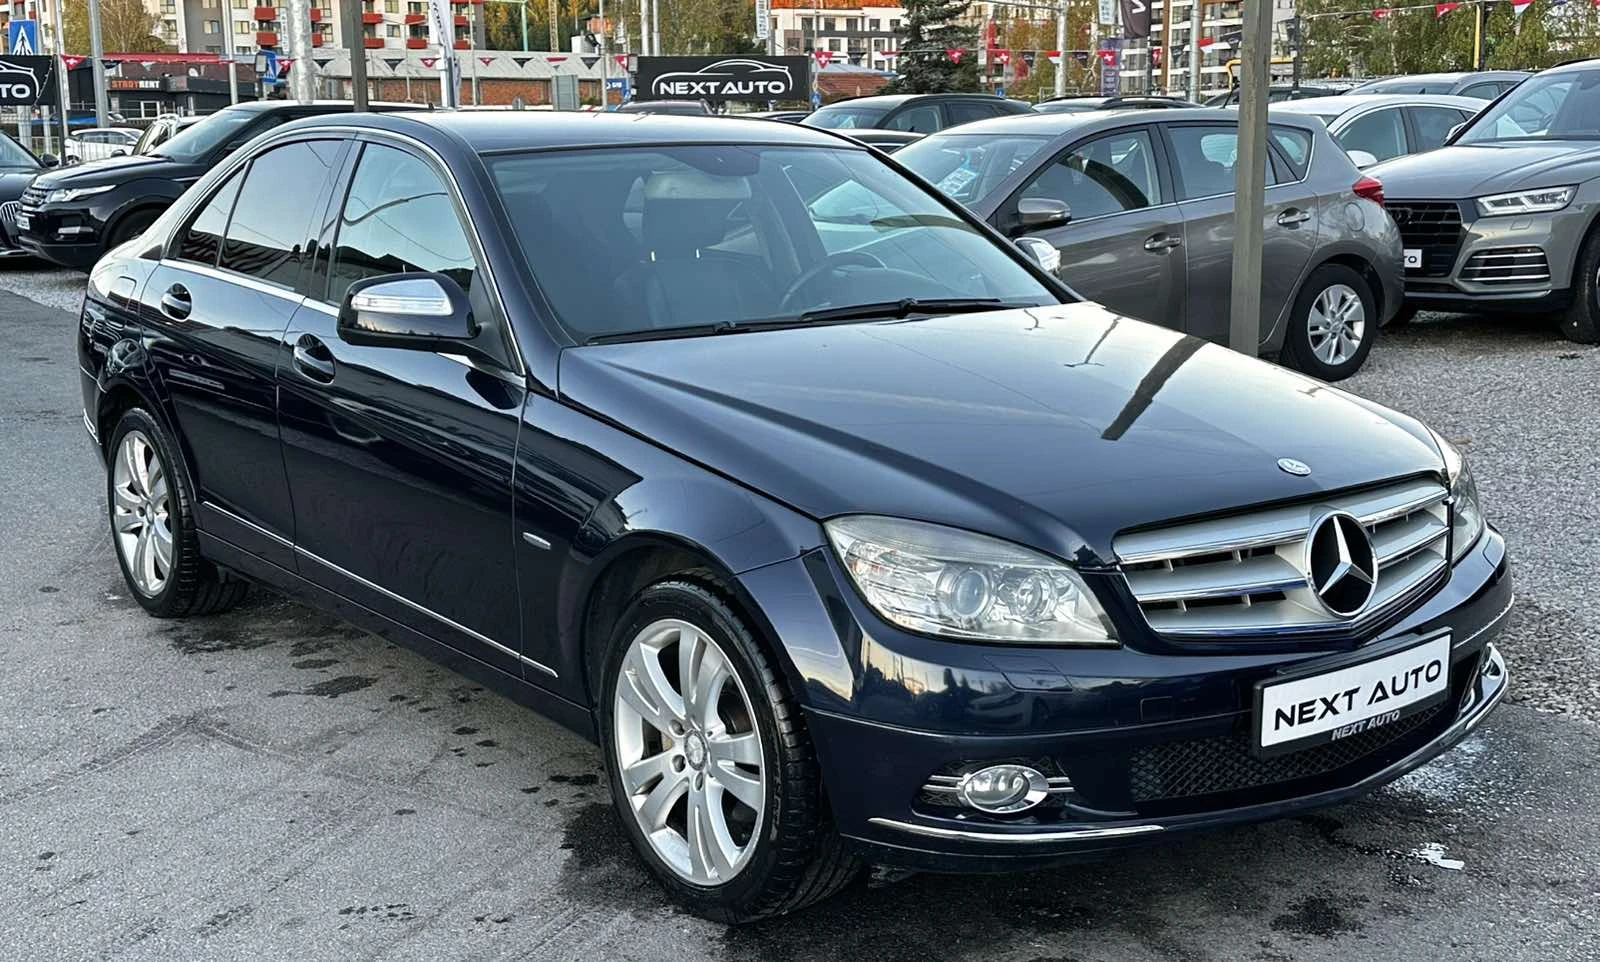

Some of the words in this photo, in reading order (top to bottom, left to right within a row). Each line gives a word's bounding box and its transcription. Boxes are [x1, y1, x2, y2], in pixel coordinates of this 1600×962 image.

[660, 81, 720, 95] NEXT
[721, 81, 785, 95] AUTO
[1274, 686, 1361, 731] NEXT
[1367, 659, 1442, 706] AUTO
[1331, 720, 1366, 741] NEXT
[1367, 709, 1400, 729] AUTO
